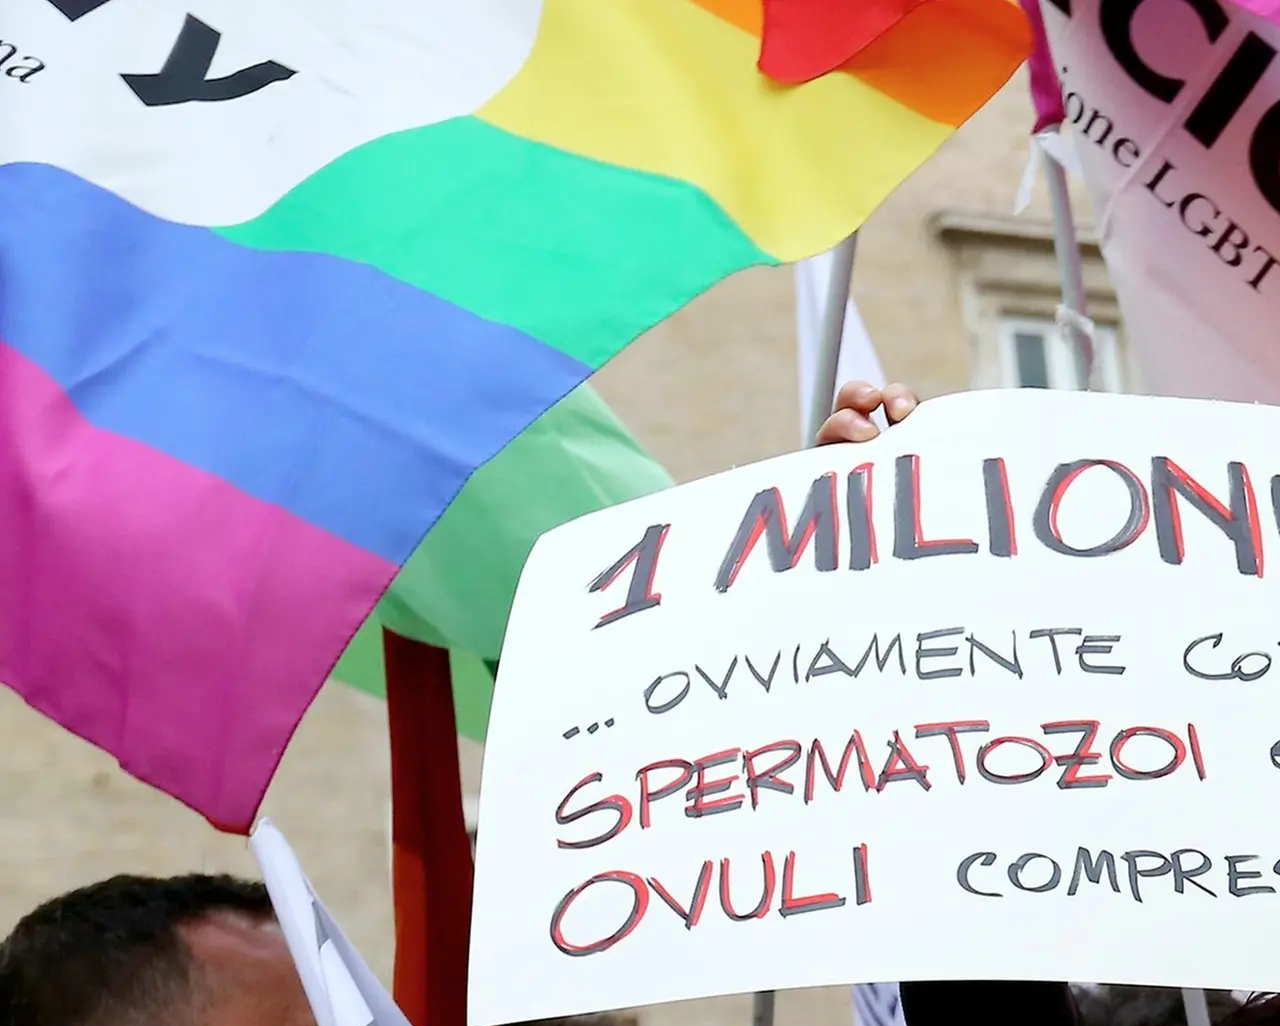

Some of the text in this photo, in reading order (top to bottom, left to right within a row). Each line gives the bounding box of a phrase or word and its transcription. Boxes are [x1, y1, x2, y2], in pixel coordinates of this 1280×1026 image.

[586, 523, 673, 631] 1
[555, 718, 1206, 850] SPERMATOZOI
[549, 841, 874, 958] OVULI
